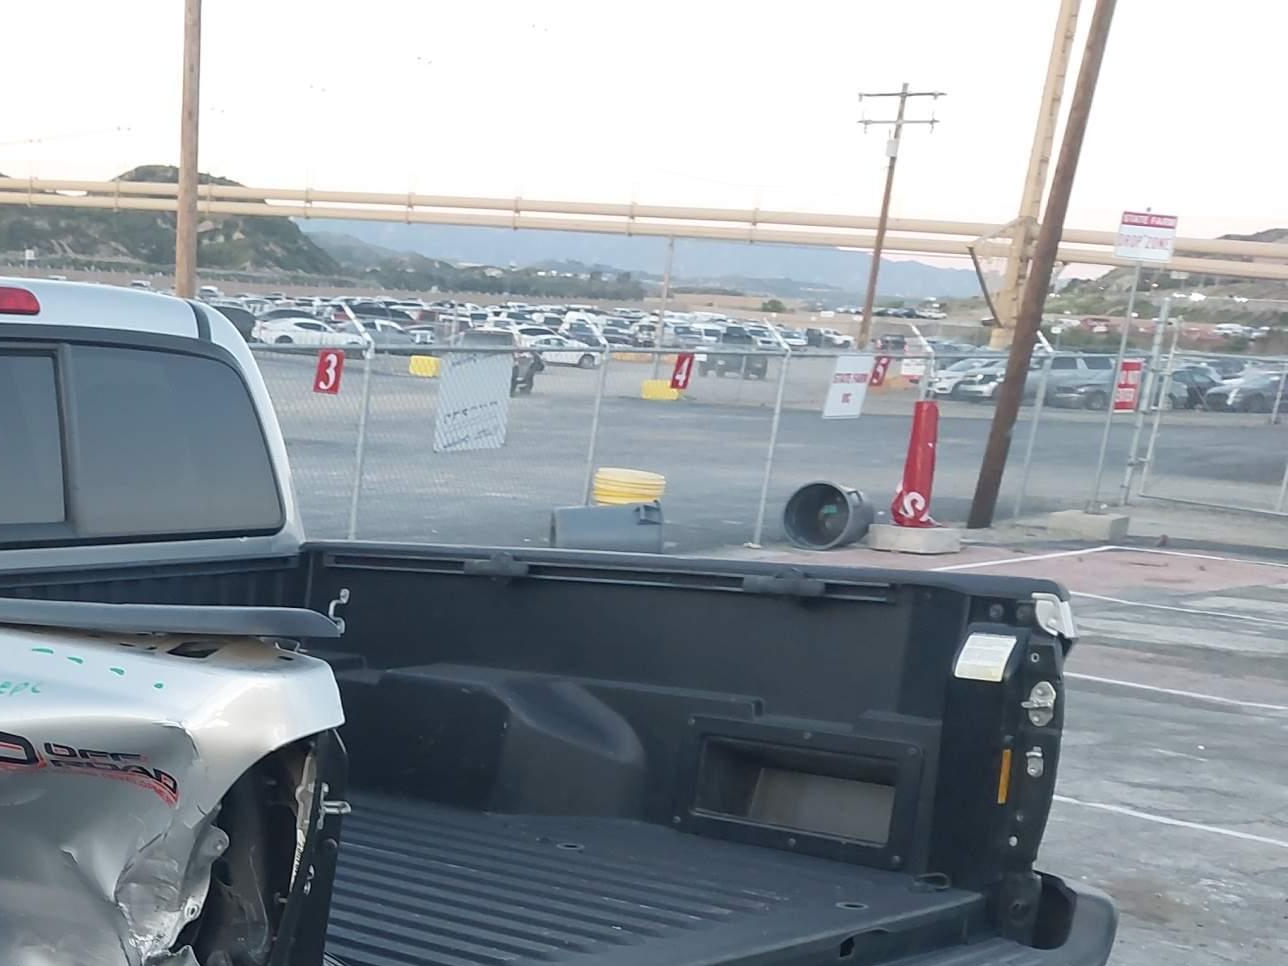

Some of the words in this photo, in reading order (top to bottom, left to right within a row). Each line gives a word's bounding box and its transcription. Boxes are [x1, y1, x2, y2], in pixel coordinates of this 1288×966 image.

[319, 353, 338, 390] 3
[674, 356, 690, 387] 4
[43, 742, 150, 761] OFF
